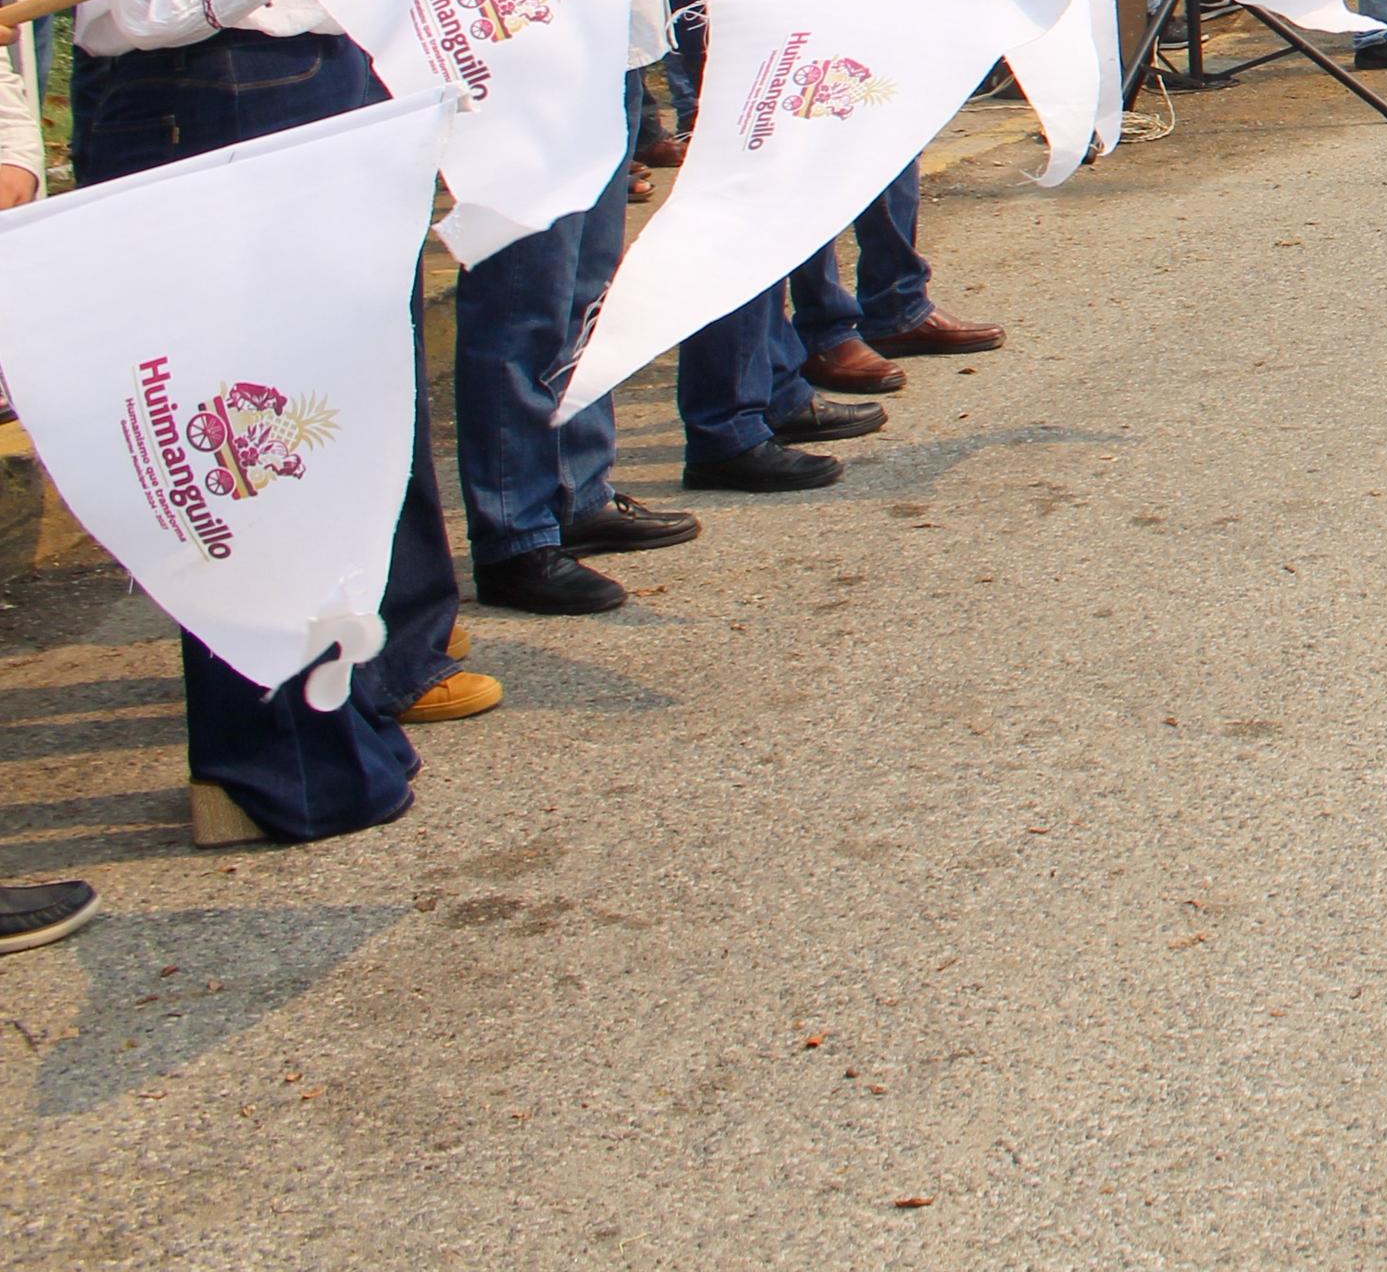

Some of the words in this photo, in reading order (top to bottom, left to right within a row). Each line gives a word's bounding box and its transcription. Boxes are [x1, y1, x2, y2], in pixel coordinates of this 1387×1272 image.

[748, 32, 811, 151] Huimanguillo
[125, 398, 150, 464] Humanismo
[145, 467, 159, 487] que
[155, 489, 187, 543] transforma
[139, 356, 234, 559] Huimanguillo
